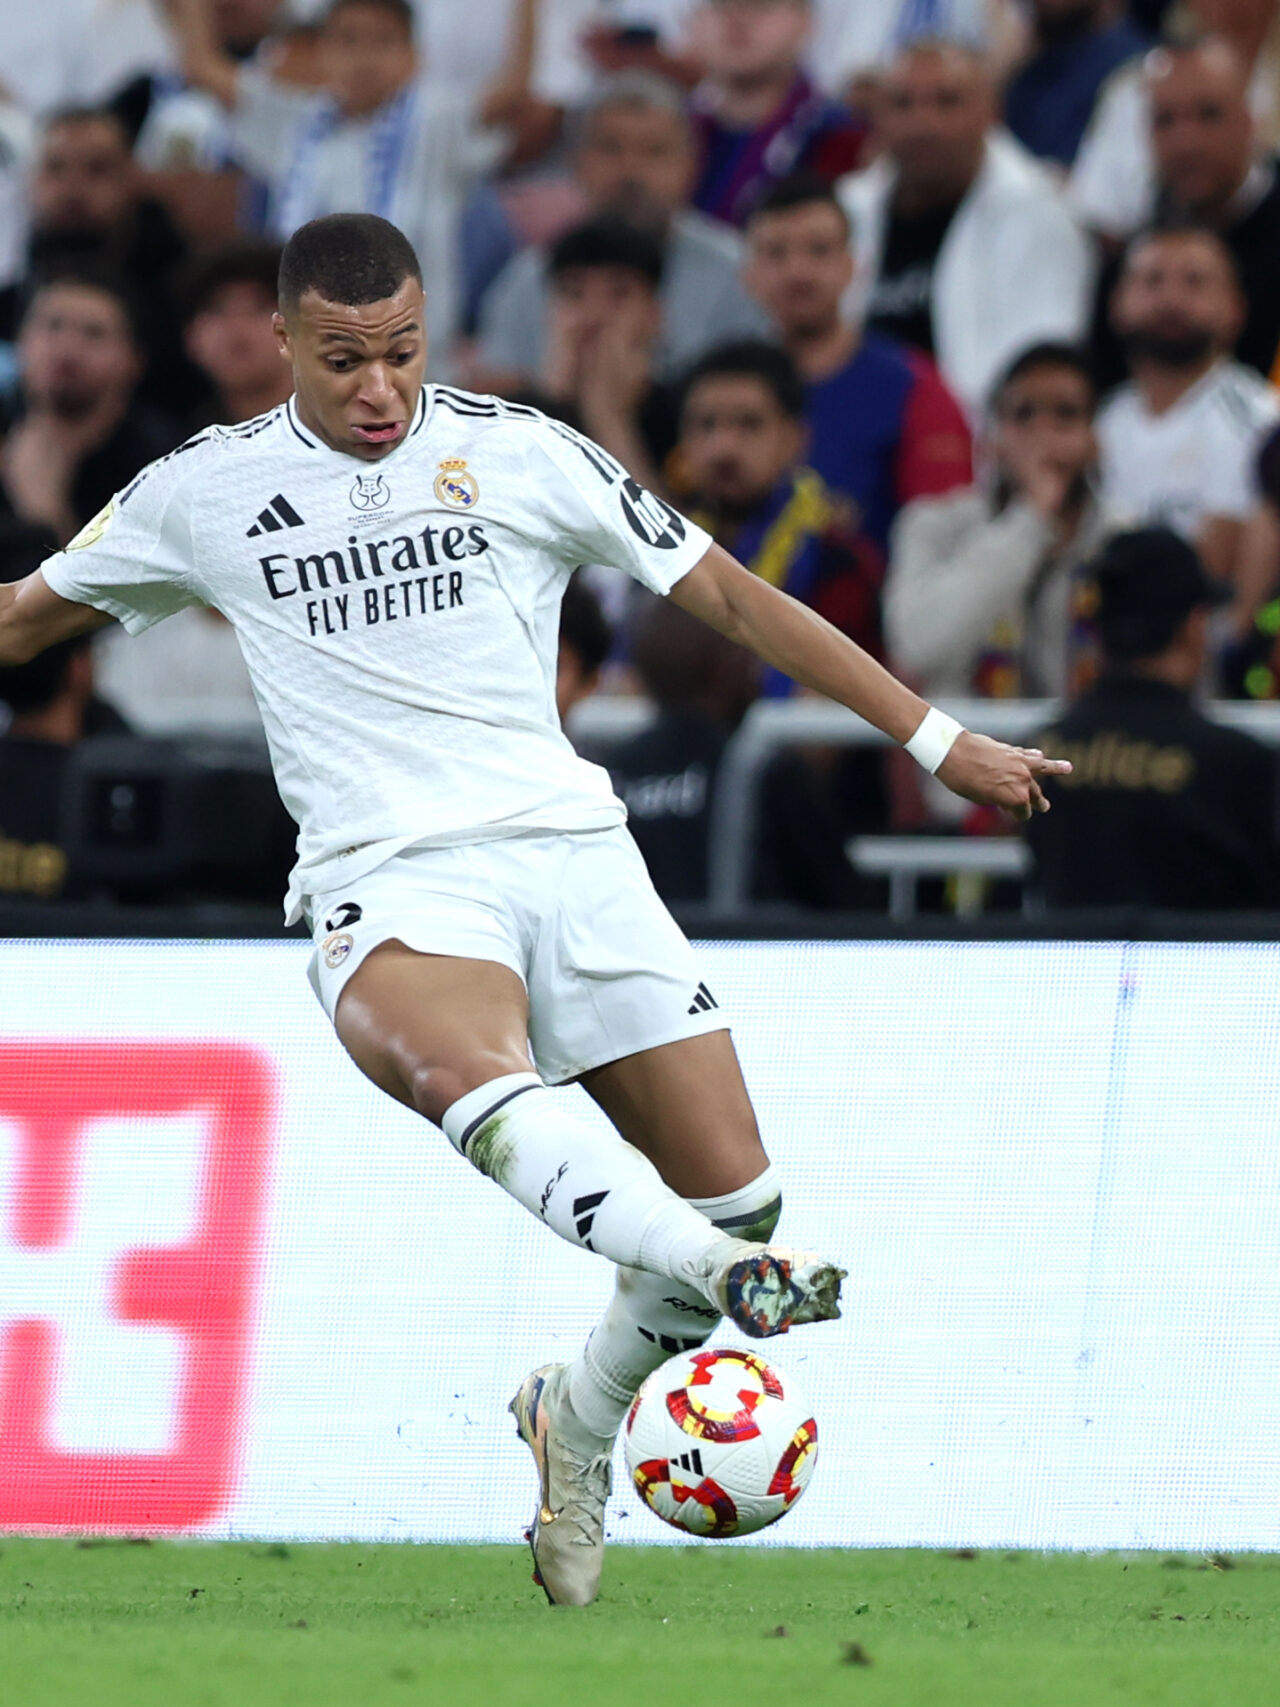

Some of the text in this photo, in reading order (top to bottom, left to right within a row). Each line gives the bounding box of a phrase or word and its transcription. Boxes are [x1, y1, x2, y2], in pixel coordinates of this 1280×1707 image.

[259, 525, 490, 600] Emirates
[306, 571, 464, 636] FLY BETTER
